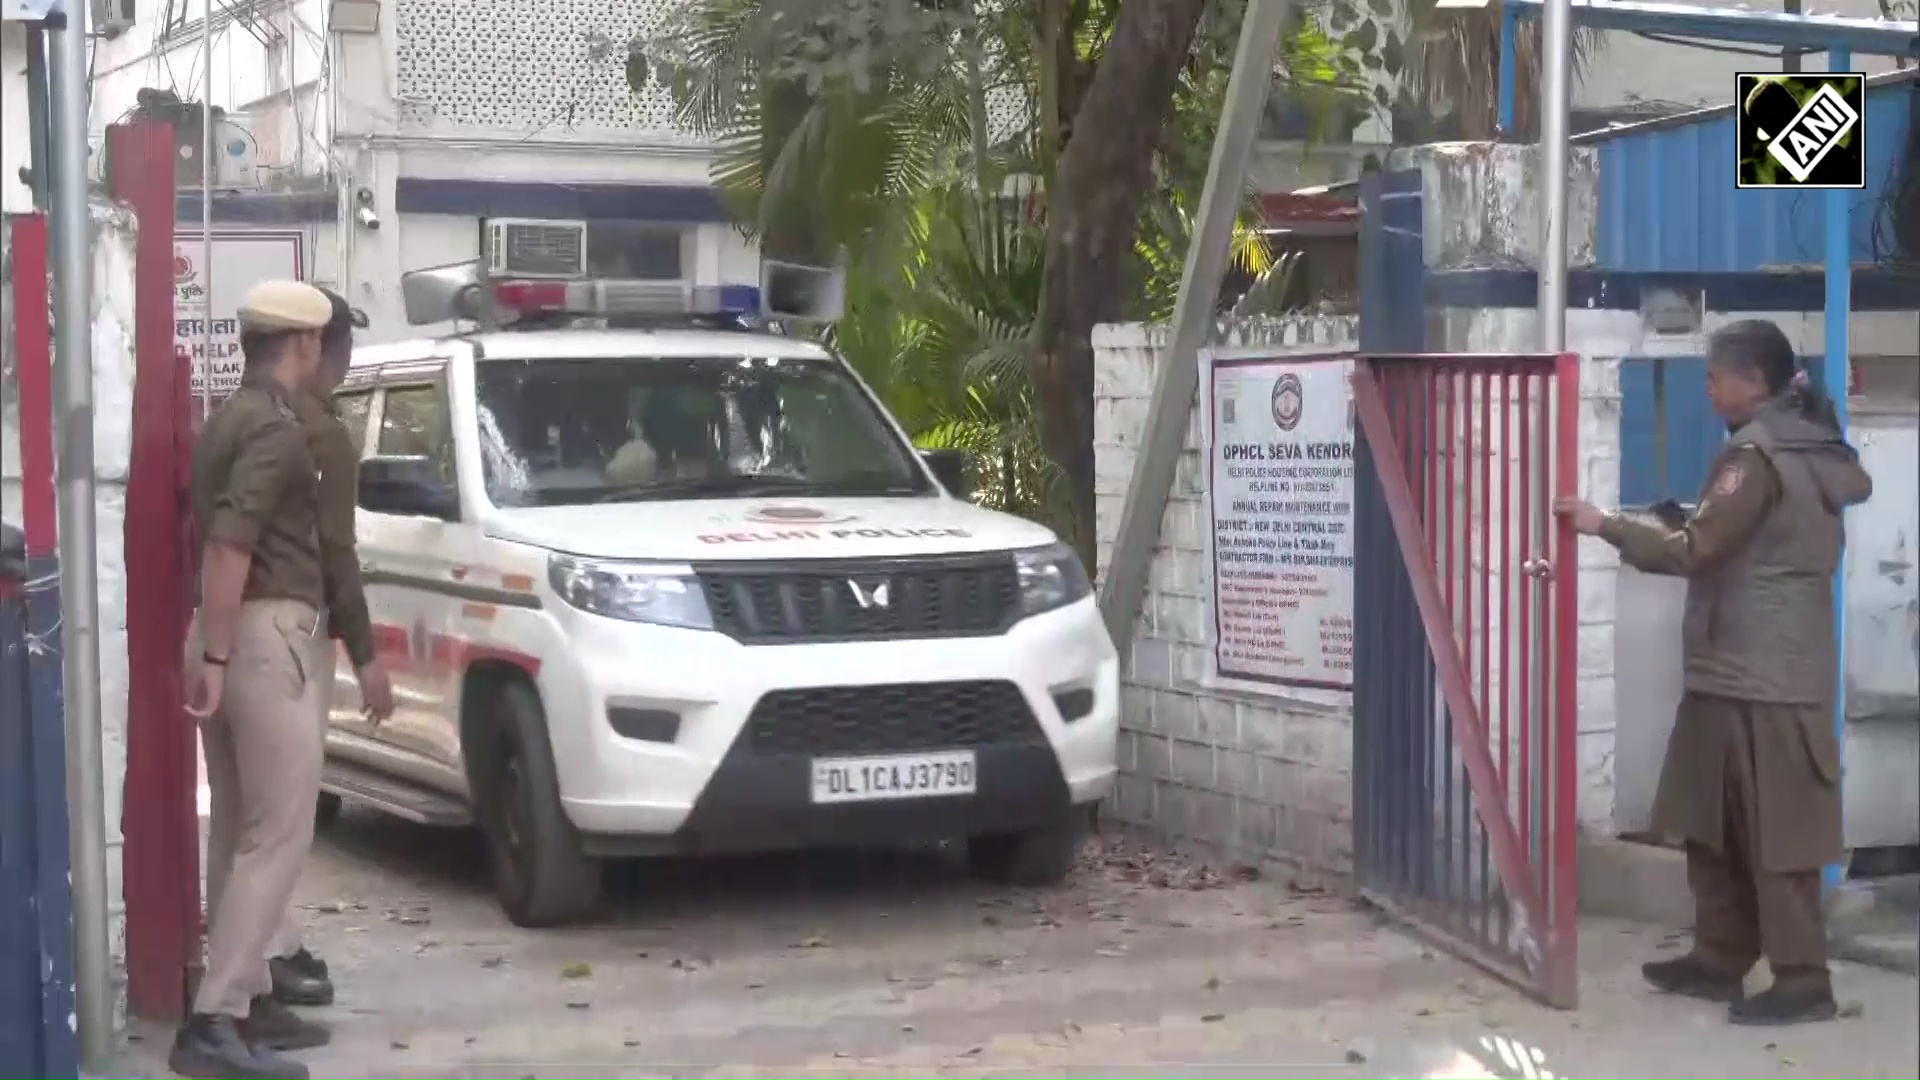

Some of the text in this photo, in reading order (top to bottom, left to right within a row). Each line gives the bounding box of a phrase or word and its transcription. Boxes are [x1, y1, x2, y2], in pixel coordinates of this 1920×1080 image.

[1268, 443, 1302, 460] SEVA
[1306, 443, 1352, 460] KENDR
[696, 527, 974, 544] DELHI POLICE
[828, 761, 972, 794] DL1CAJ3790
